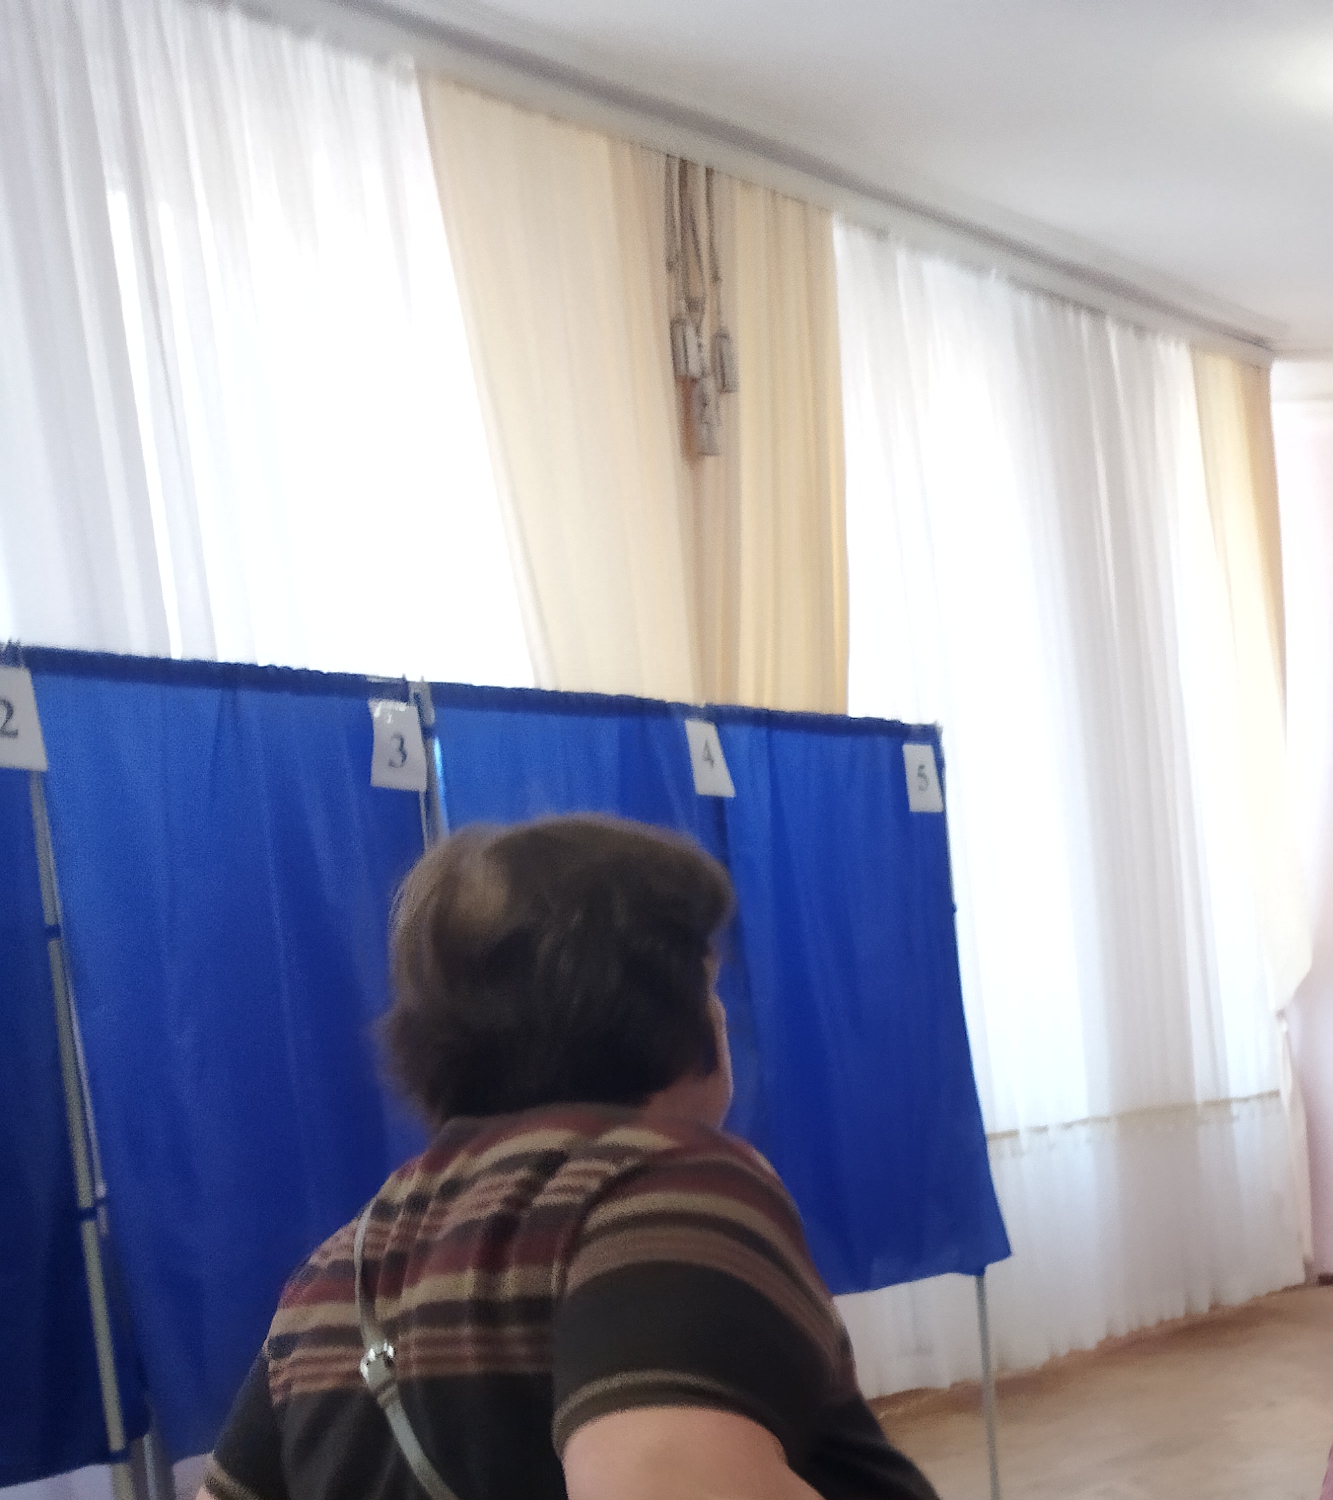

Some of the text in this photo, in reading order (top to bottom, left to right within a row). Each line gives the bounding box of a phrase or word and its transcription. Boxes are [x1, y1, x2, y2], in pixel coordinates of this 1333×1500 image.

[0, 697, 18, 738] 2
[388, 732, 407, 769] 3
[702, 738, 715, 769] 4
[917, 764, 930, 792] 5
